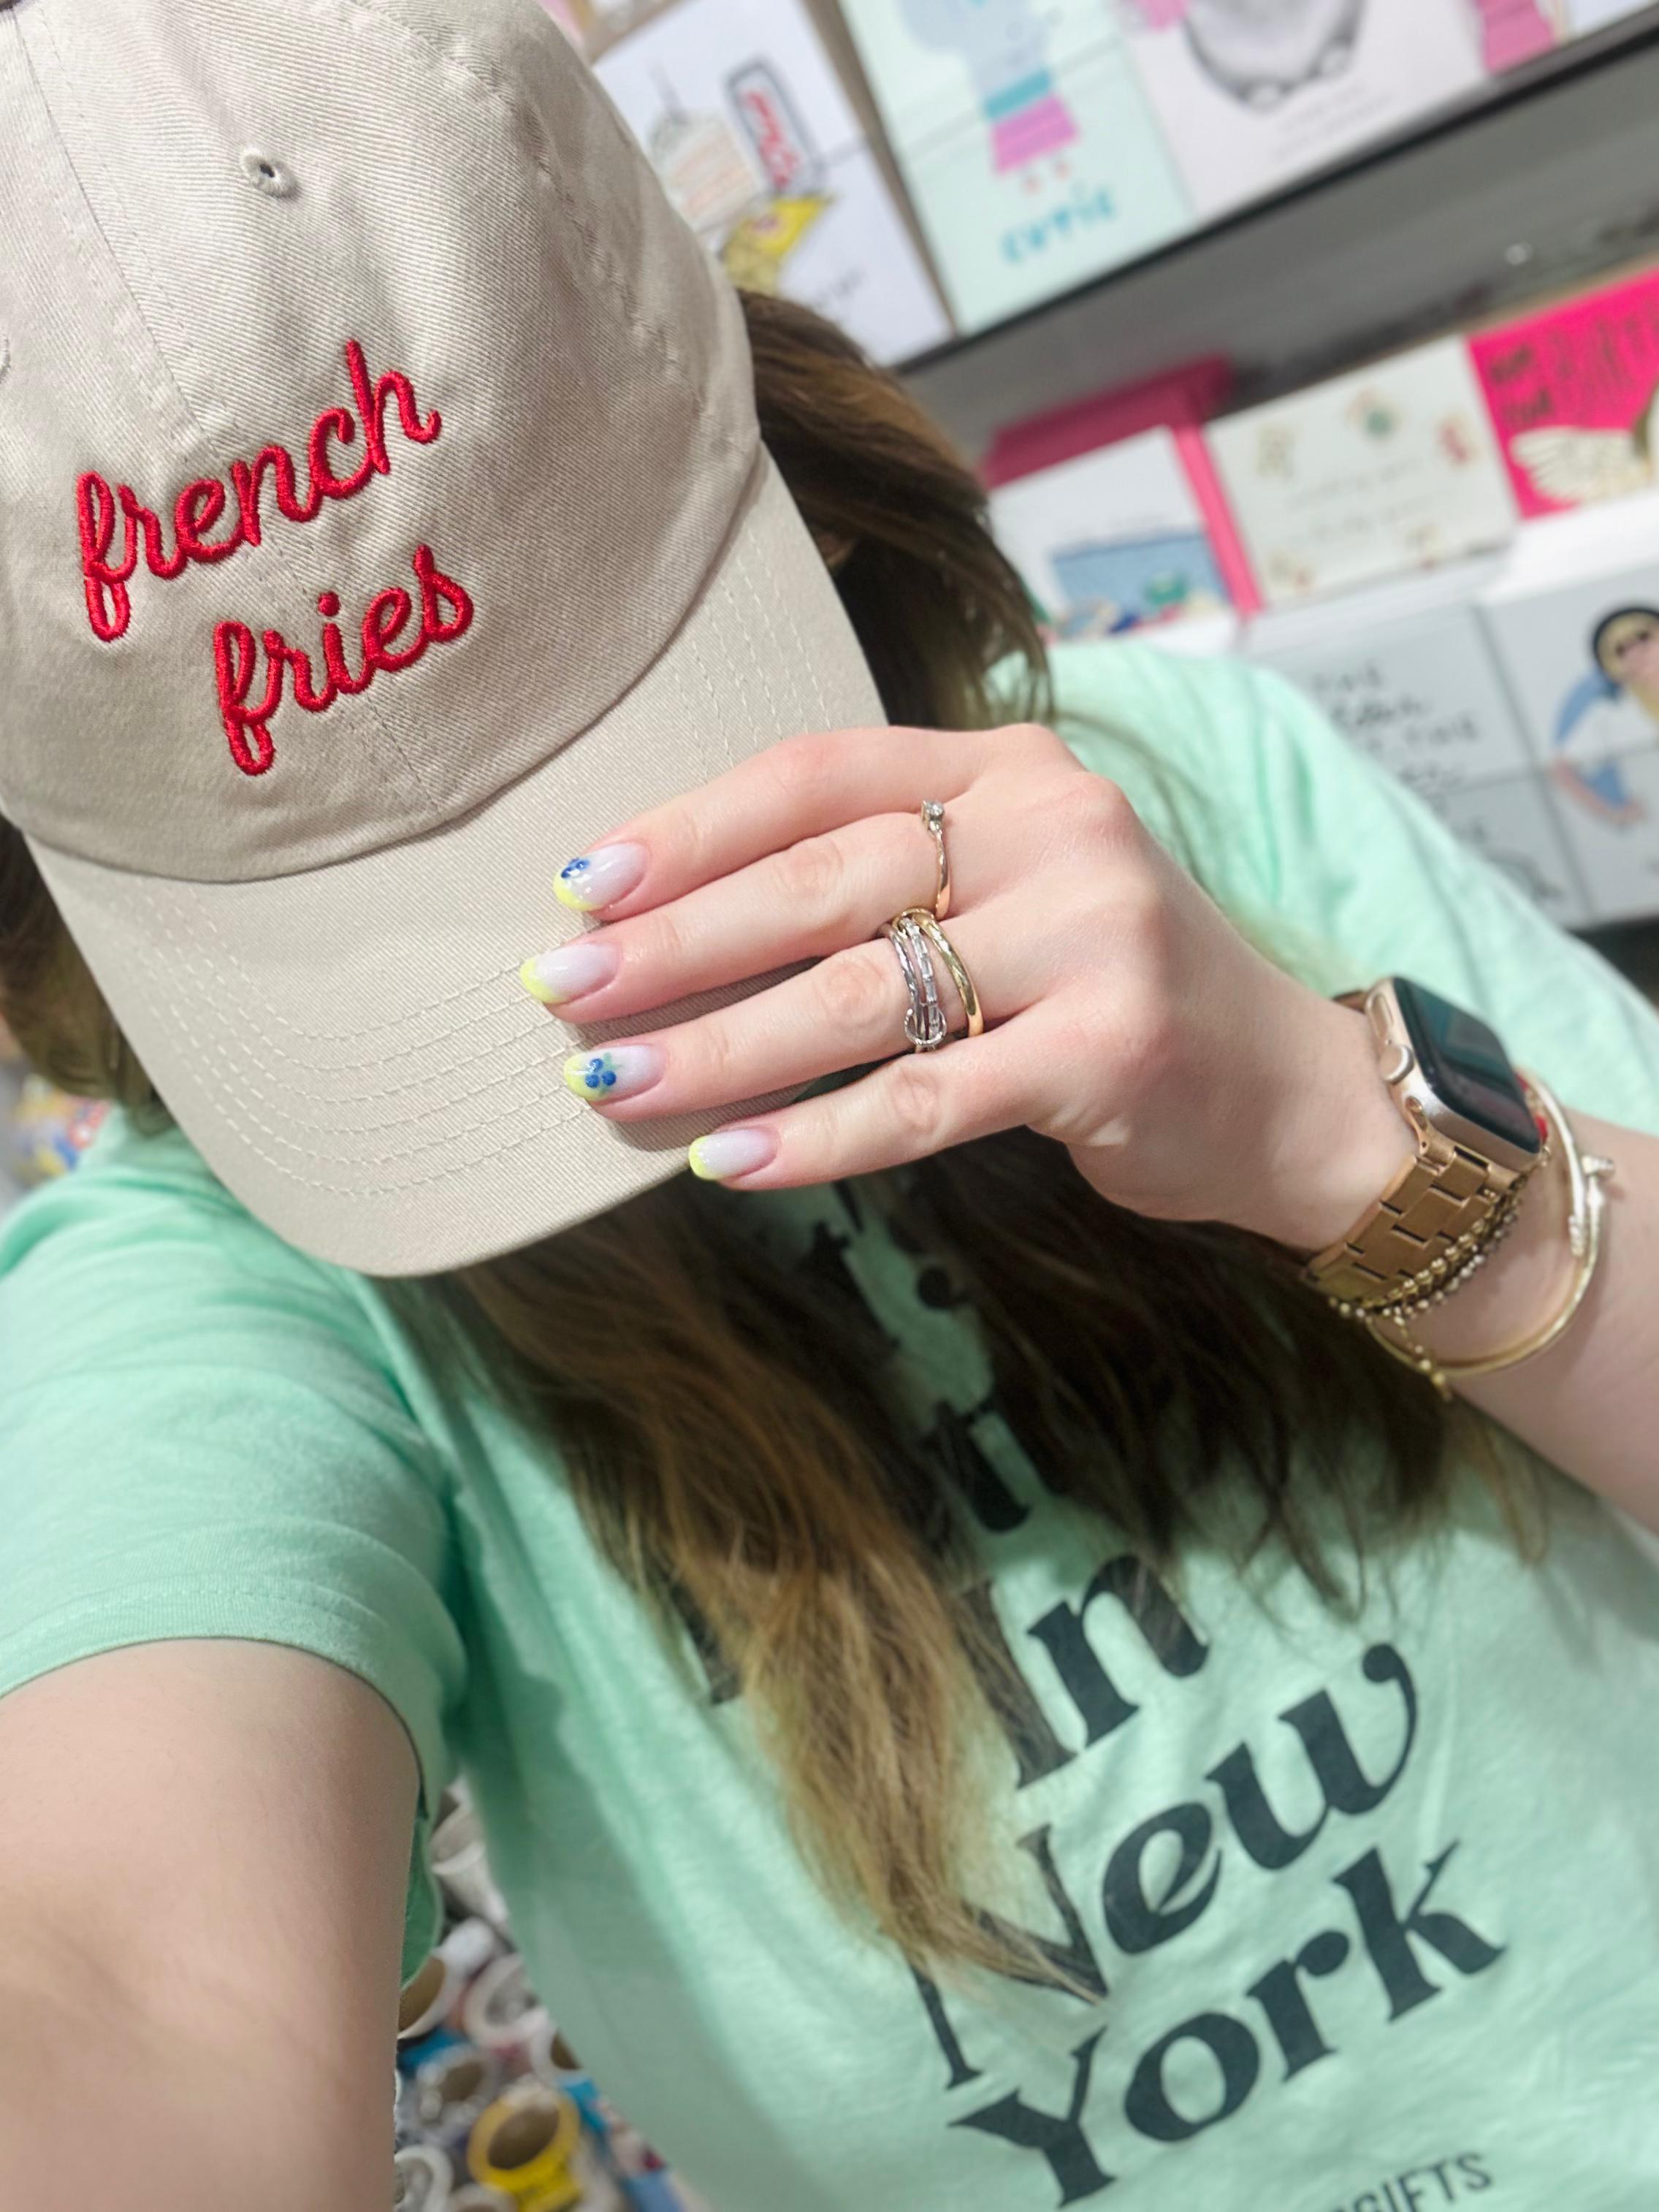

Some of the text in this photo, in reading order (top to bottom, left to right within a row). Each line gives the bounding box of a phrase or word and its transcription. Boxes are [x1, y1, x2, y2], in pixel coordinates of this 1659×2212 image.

[76, 338, 441, 643] french
[213, 545, 473, 776] fries
[897, 1643, 1417, 2091] New
[947, 1838, 1507, 2209] York
